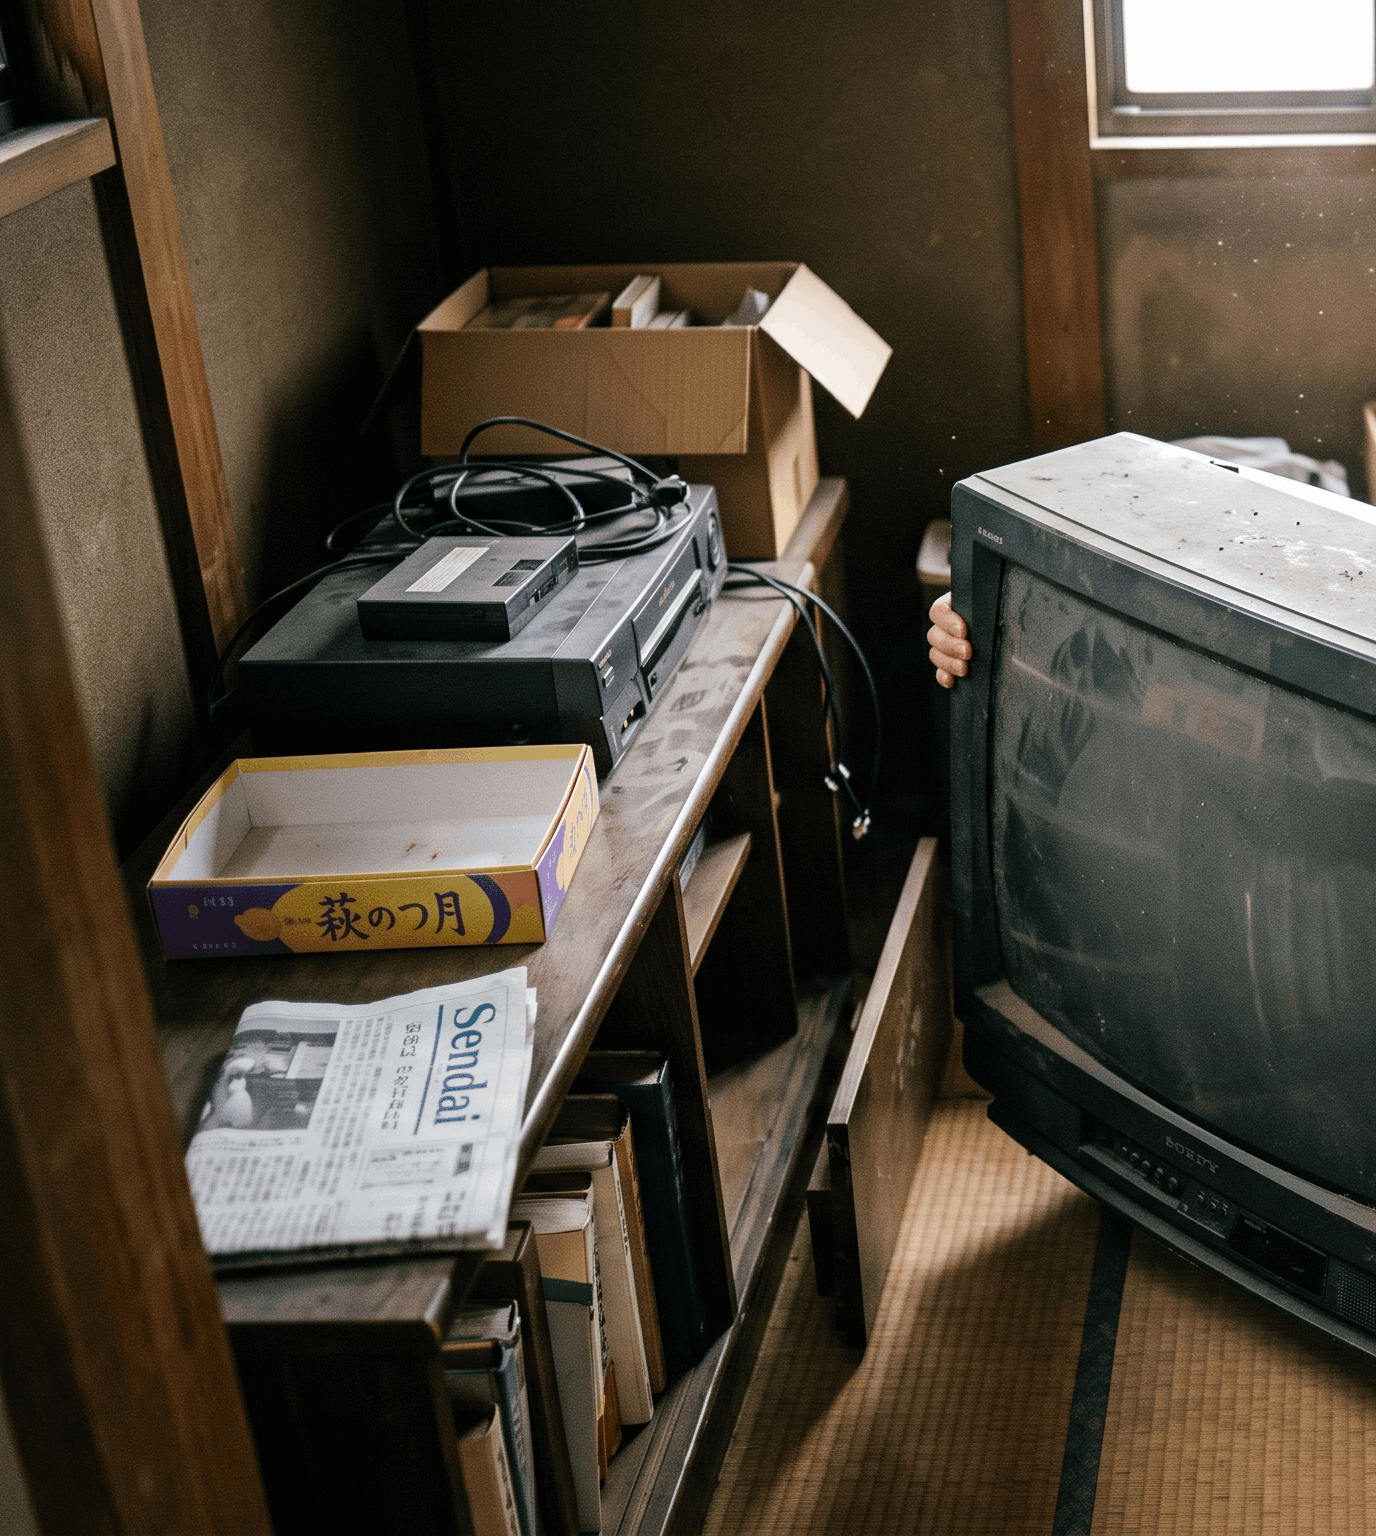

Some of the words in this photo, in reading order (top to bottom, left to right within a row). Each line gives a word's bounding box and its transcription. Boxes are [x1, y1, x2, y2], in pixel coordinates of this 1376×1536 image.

[315, 891, 466, 942] 萩のつ月
[434, 1002, 496, 1126] Sendai
